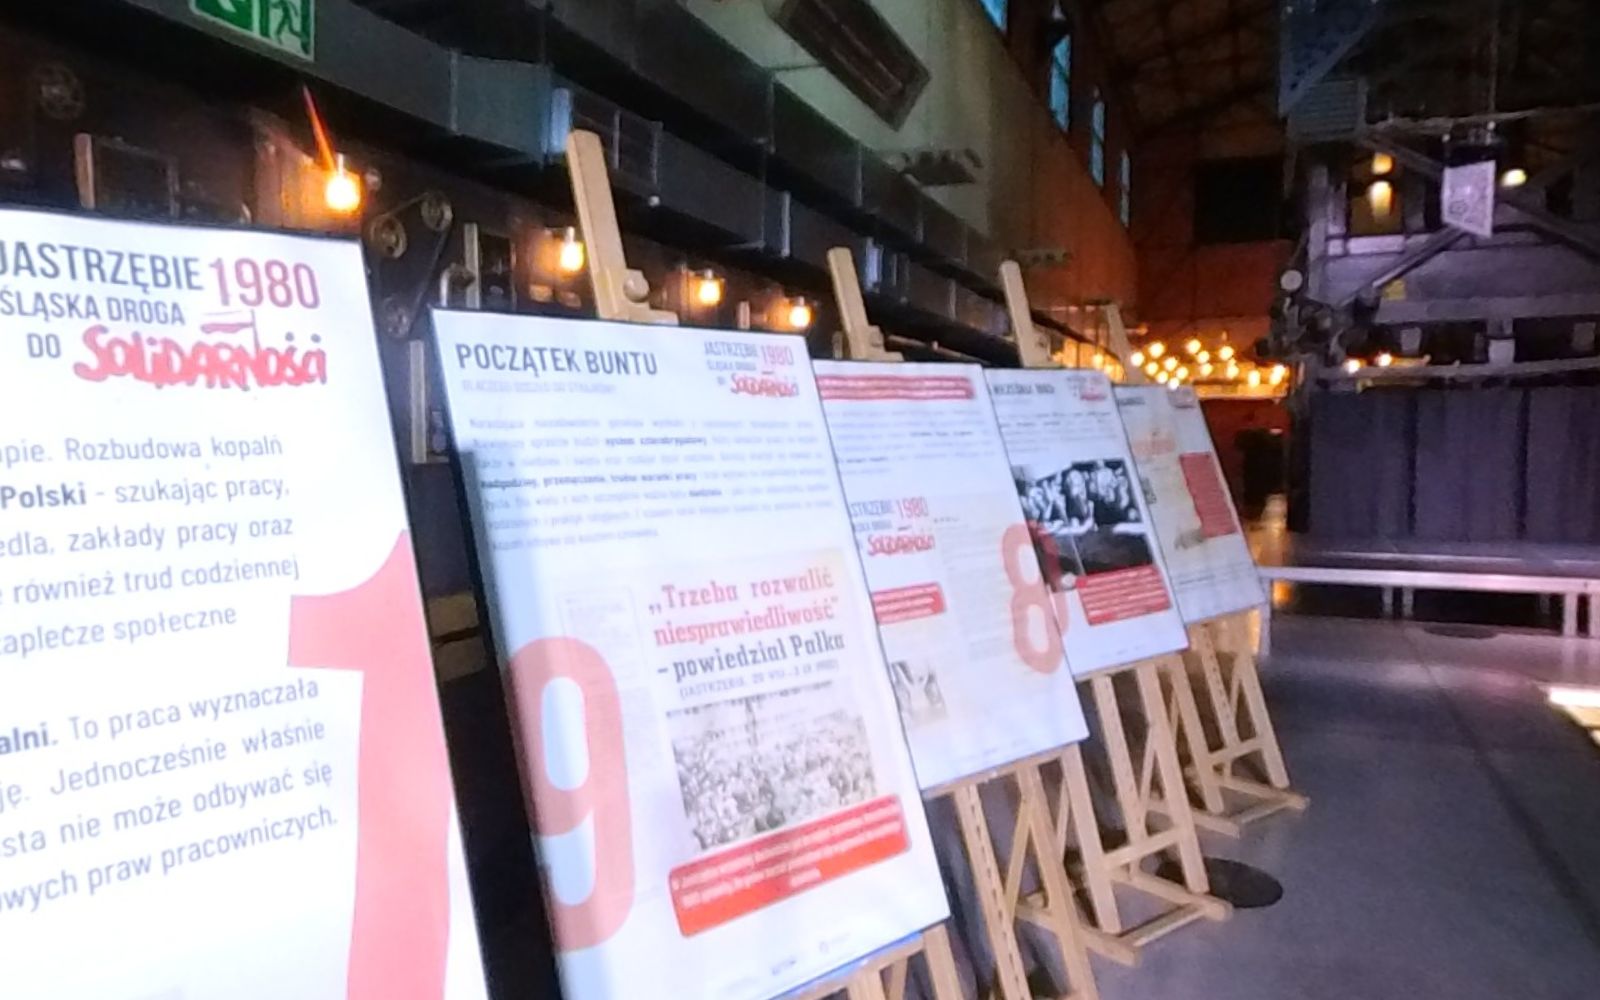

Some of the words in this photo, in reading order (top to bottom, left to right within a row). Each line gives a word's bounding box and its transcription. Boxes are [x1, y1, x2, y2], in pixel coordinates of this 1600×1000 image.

[0, 240, 204, 294] JASTRZĘBIE
[209, 256, 321, 310] 1980
[0, 288, 101, 322] ŚLĄSKA
[106, 295, 186, 326] DROGA
[27, 331, 62, 359] DO
[455, 342, 583, 377] POCZĄTEK
[585, 350, 658, 375] BUNTU
[760, 345, 794, 366] 1980
[0, 439, 53, 469] pie.
[64, 437, 201, 461] Rozbudowa
[210, 435, 284, 460] kopalń
[0, 482, 87, 510] Polski
[115, 477, 218, 506] szukając
[225, 476, 291, 502] pracy,
[895, 496, 929, 519] 1980
[67, 522, 165, 552] zakłady
[177, 519, 238, 549] pracy
[248, 517, 293, 539] oraz
[13, 570, 116, 604] również
[124, 566, 173, 592] trud
[181, 554, 301, 588] codziennej
[750, 567, 836, 598] rozwalić
[0, 624, 105, 659] aplecze
[113, 605, 237, 645] społeczne
[788, 629, 845, 658] Pałka
[68, 715, 100, 740] To
[108, 703, 181, 740] praca
[189, 677, 319, 722] wyznaczała
[50, 739, 227, 796] Jednocześnie
[242, 718, 326, 756] właśnie
[2, 829, 47, 858] sta
[59, 813, 101, 845] nie
[113, 796, 182, 832] może
[193, 767, 295, 809] odbywać
[303, 760, 333, 788] się
[0, 868, 78, 913] wych
[87, 852, 152, 896] praw
[160, 804, 339, 877] pracowniczych.
